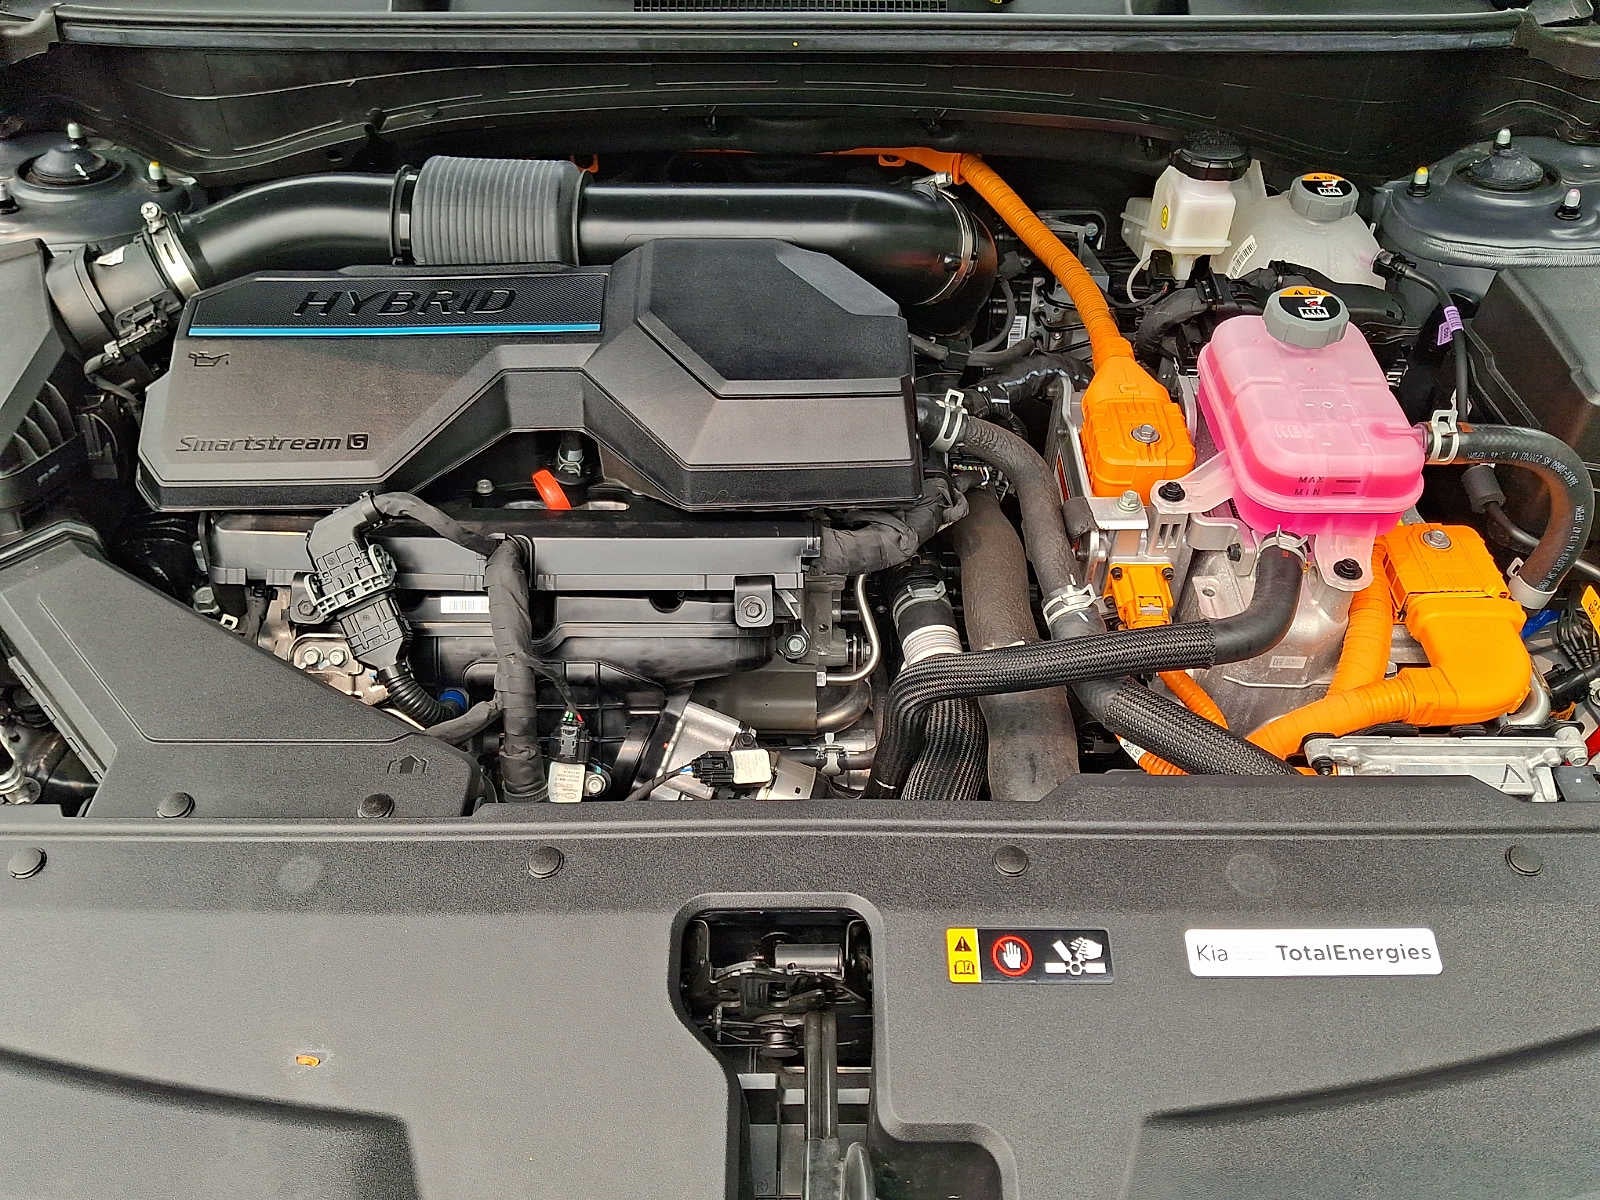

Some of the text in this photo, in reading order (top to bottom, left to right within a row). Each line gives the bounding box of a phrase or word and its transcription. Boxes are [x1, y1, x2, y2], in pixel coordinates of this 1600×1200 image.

[293, 289, 516, 316] HYBRID
[176, 435, 342, 452] Smartstream
[1298, 476, 1324, 484] MAX
[1295, 488, 1320, 496] MIN
[1196, 943, 1433, 963] Kia TotalEnergies
